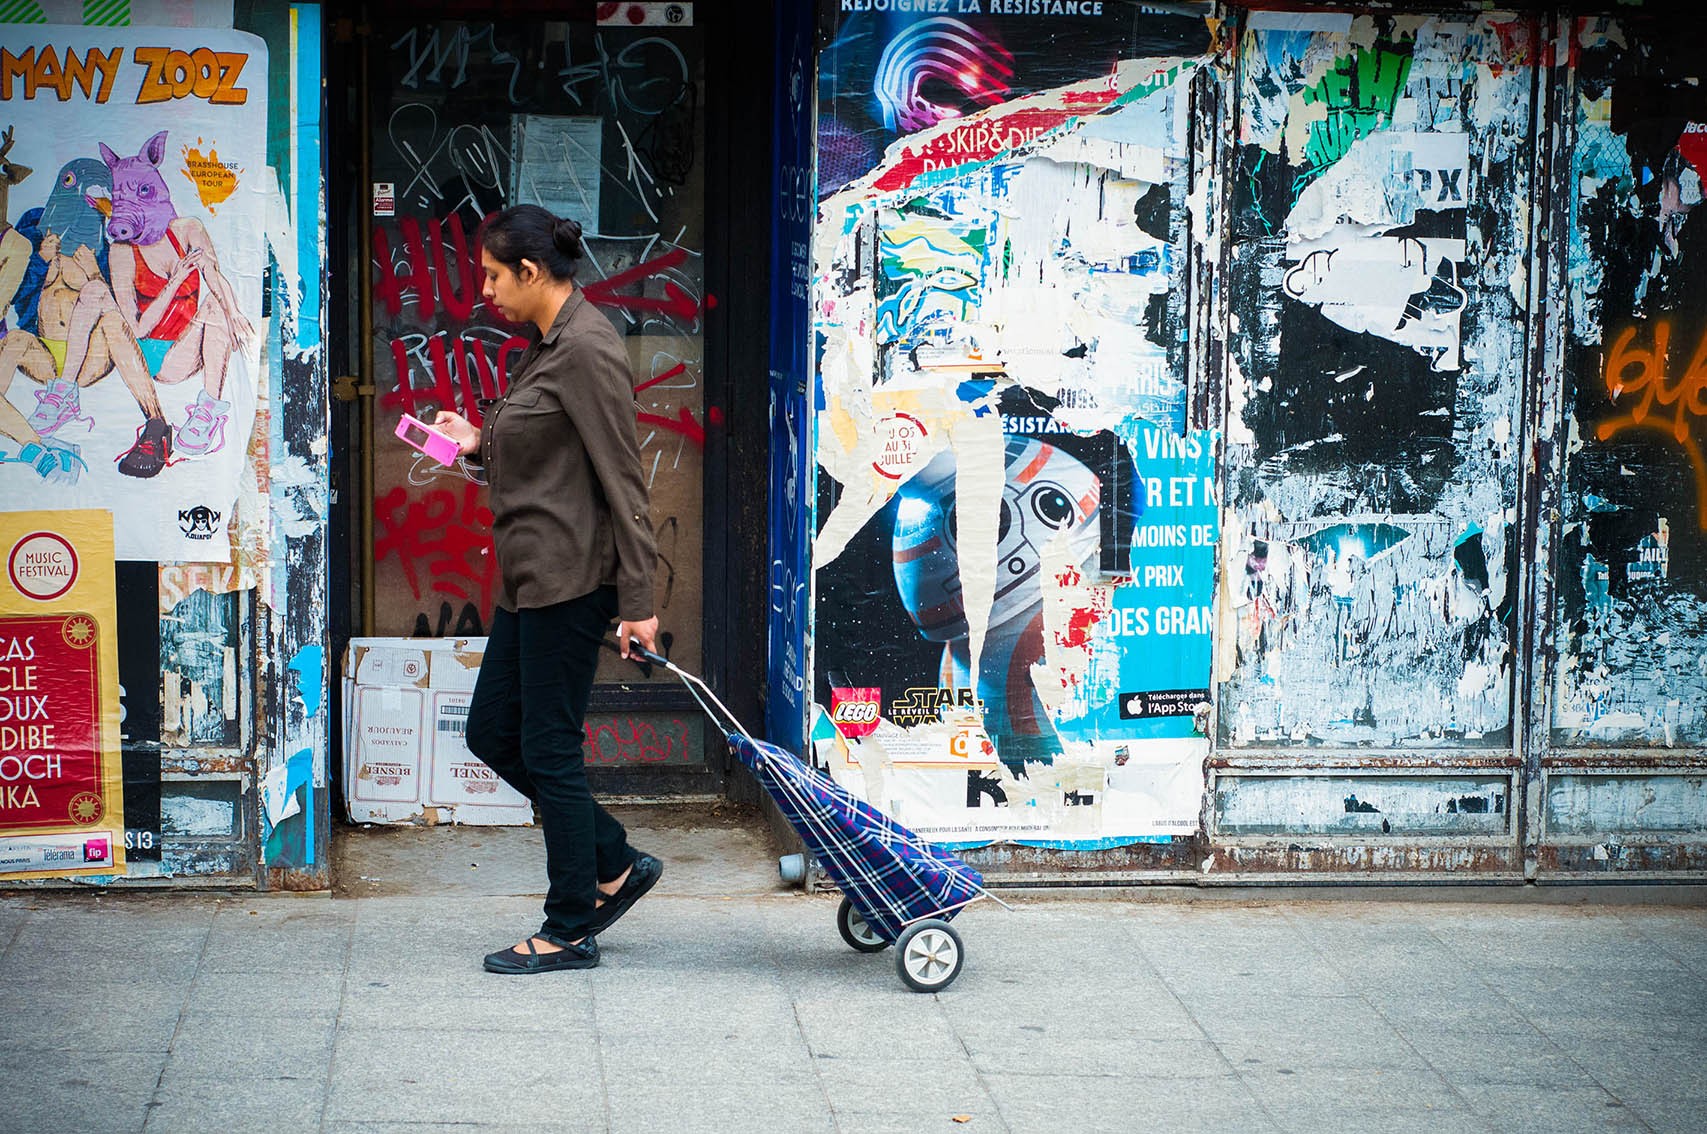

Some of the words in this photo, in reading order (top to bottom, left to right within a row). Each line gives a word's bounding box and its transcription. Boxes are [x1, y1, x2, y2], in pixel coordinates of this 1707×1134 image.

[841, 0, 949, 12] REJOIGNEZ
[958, 0, 981, 13] LA
[0, 44, 124, 104] MANY
[133, 47, 249, 105] ZOOZ
[187, 160, 239, 170] BRASSHOUSE
[191, 170, 234, 179] EUROPEAN
[202, 179, 223, 188] TOUR
[885, 440, 898, 452] AU
[1143, 427, 1202, 460] VINS
[1170, 474, 1198, 507] ET
[1132, 525, 1187, 548] MOINS
[1190, 524, 1214, 547] DE
[25, 551, 63, 564] MUSIC
[19, 563, 71, 578] FESTIVAL
[1145, 565, 1185, 588] PRIX
[1107, 606, 1150, 637] DES
[833, 702, 879, 724] LEGO
[1177, 701, 1197, 713] Sto
[136, 830, 153, 849] 13
[43, 848, 75, 861] Télérama
[88, 847, 102, 858] fip
